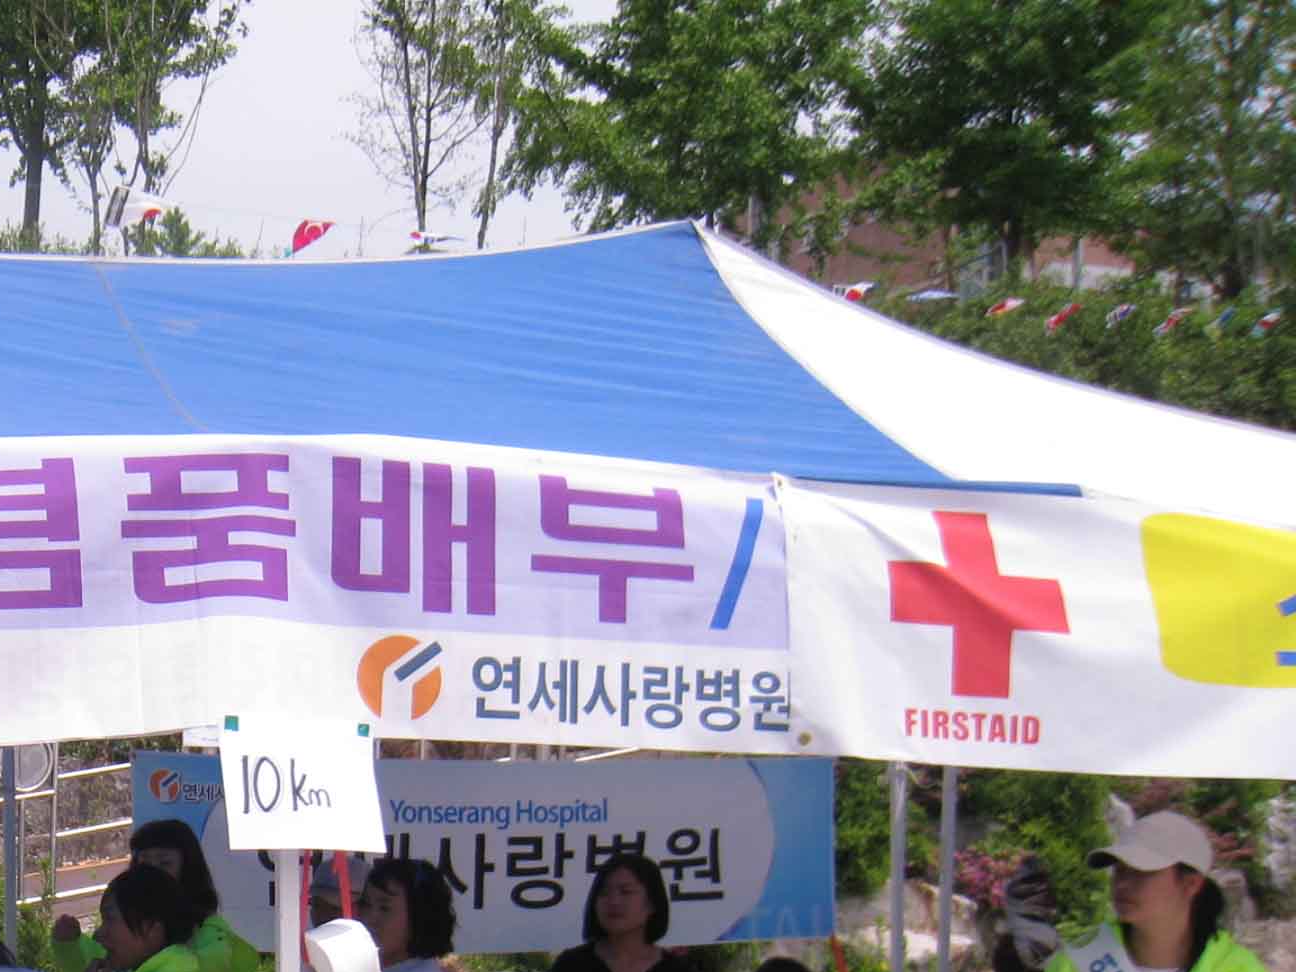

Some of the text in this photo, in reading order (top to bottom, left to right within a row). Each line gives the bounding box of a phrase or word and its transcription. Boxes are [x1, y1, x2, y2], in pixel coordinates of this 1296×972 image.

[471, 654, 791, 733] 연세사랑병원
[904, 707, 1041, 745] FIRSTAID
[389, 797, 608, 830] Yonserang Hospital
